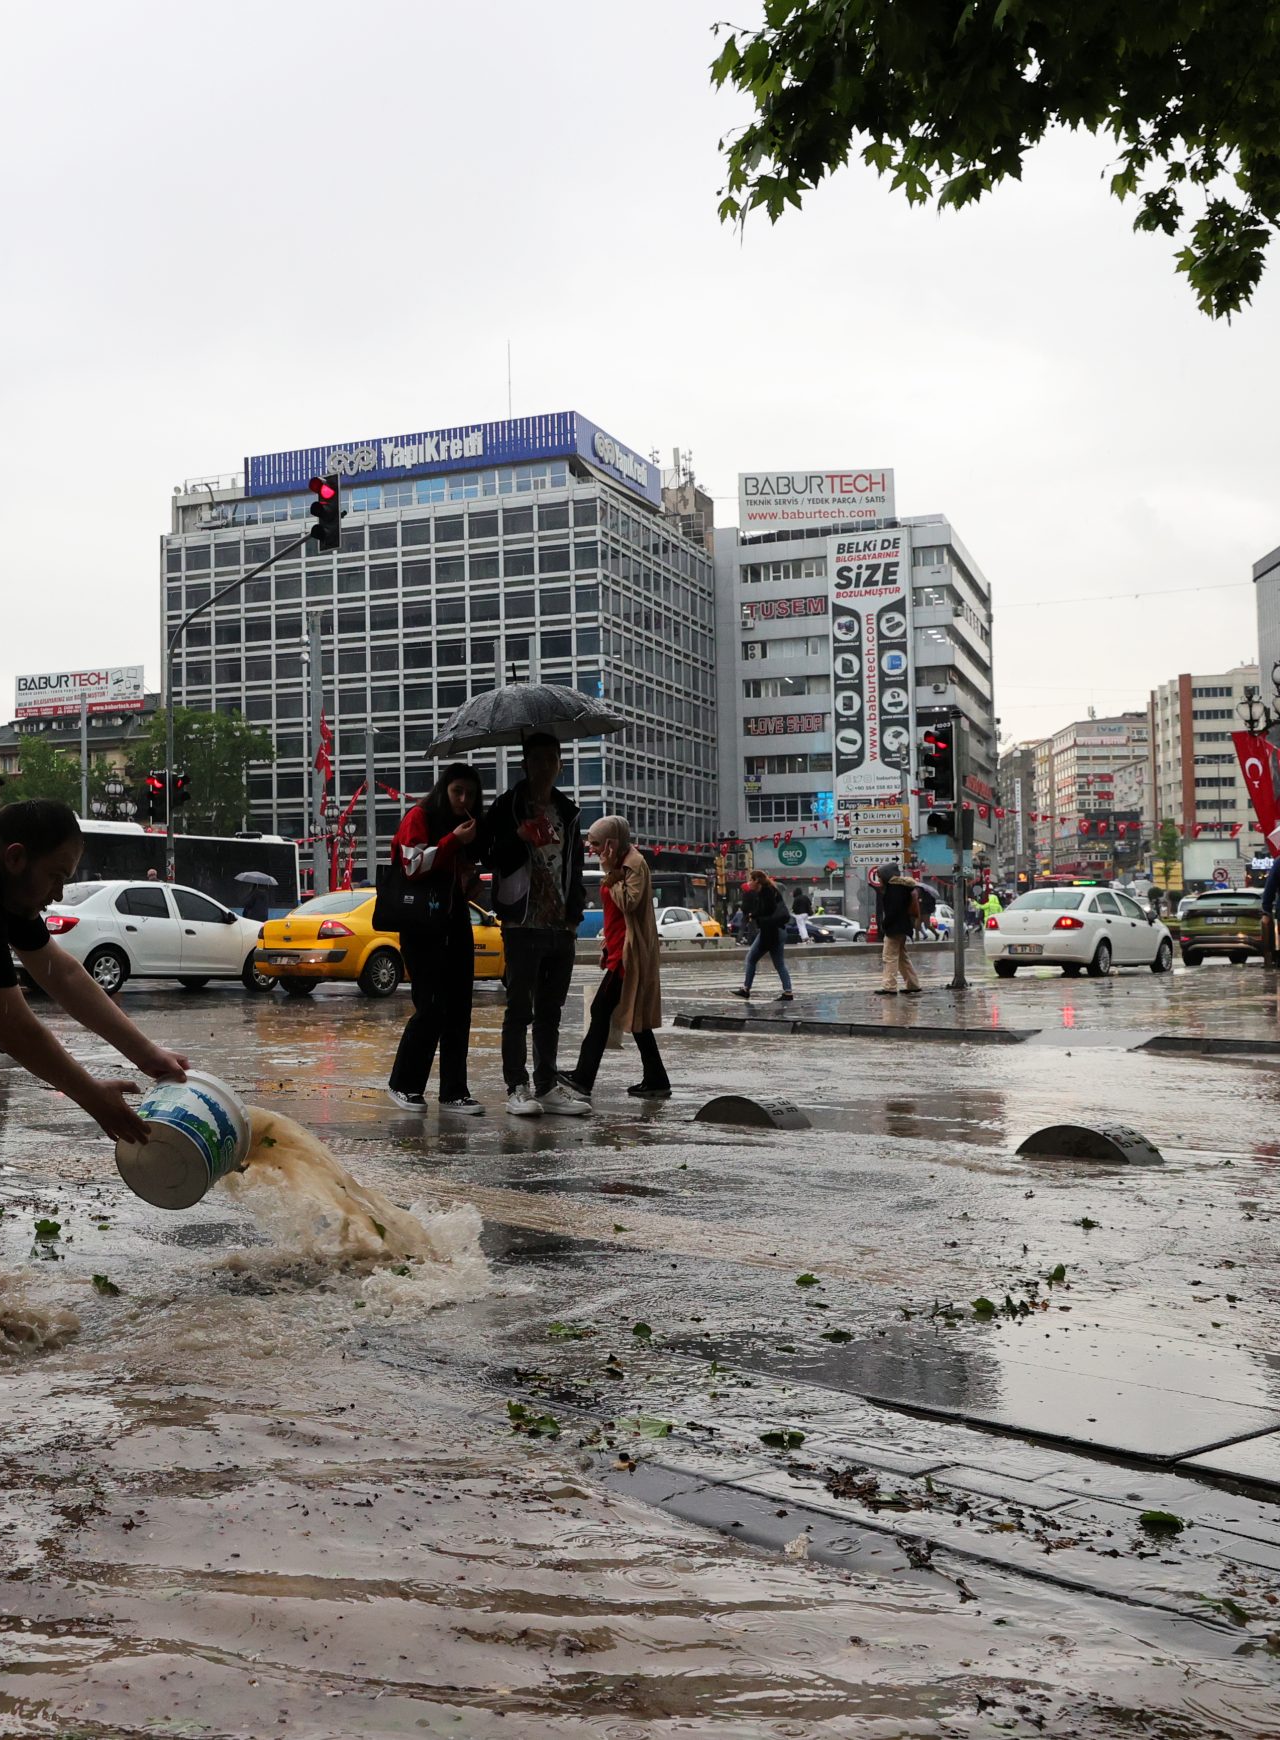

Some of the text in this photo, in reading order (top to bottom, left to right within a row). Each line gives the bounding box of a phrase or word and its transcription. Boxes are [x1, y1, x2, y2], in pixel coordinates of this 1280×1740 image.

[744, 473, 886, 496] BABURTECH
[746, 497, 772, 506] TEKNİK
[774, 497, 799, 506] SERVİS
[807, 497, 830, 505] YEDEK
[832, 496, 857, 505] PARÇA
[865, 495, 886, 505] SATIŞ
[747, 508, 877, 521] www.baburtech.com
[880, 537, 902, 551] DE
[835, 586, 901, 599] BOZULMUŞTUR
[746, 597, 825, 619] TUSEM
[18, 671, 109, 692] BABURTECH
[864, 613, 878, 762] www.baburtech.com
[750, 714, 823, 735] LOVE SHOP
[863, 812, 900, 820] Dikimevi
[782, 848, 803, 859] eko
[853, 856, 890, 864] Çankaya
